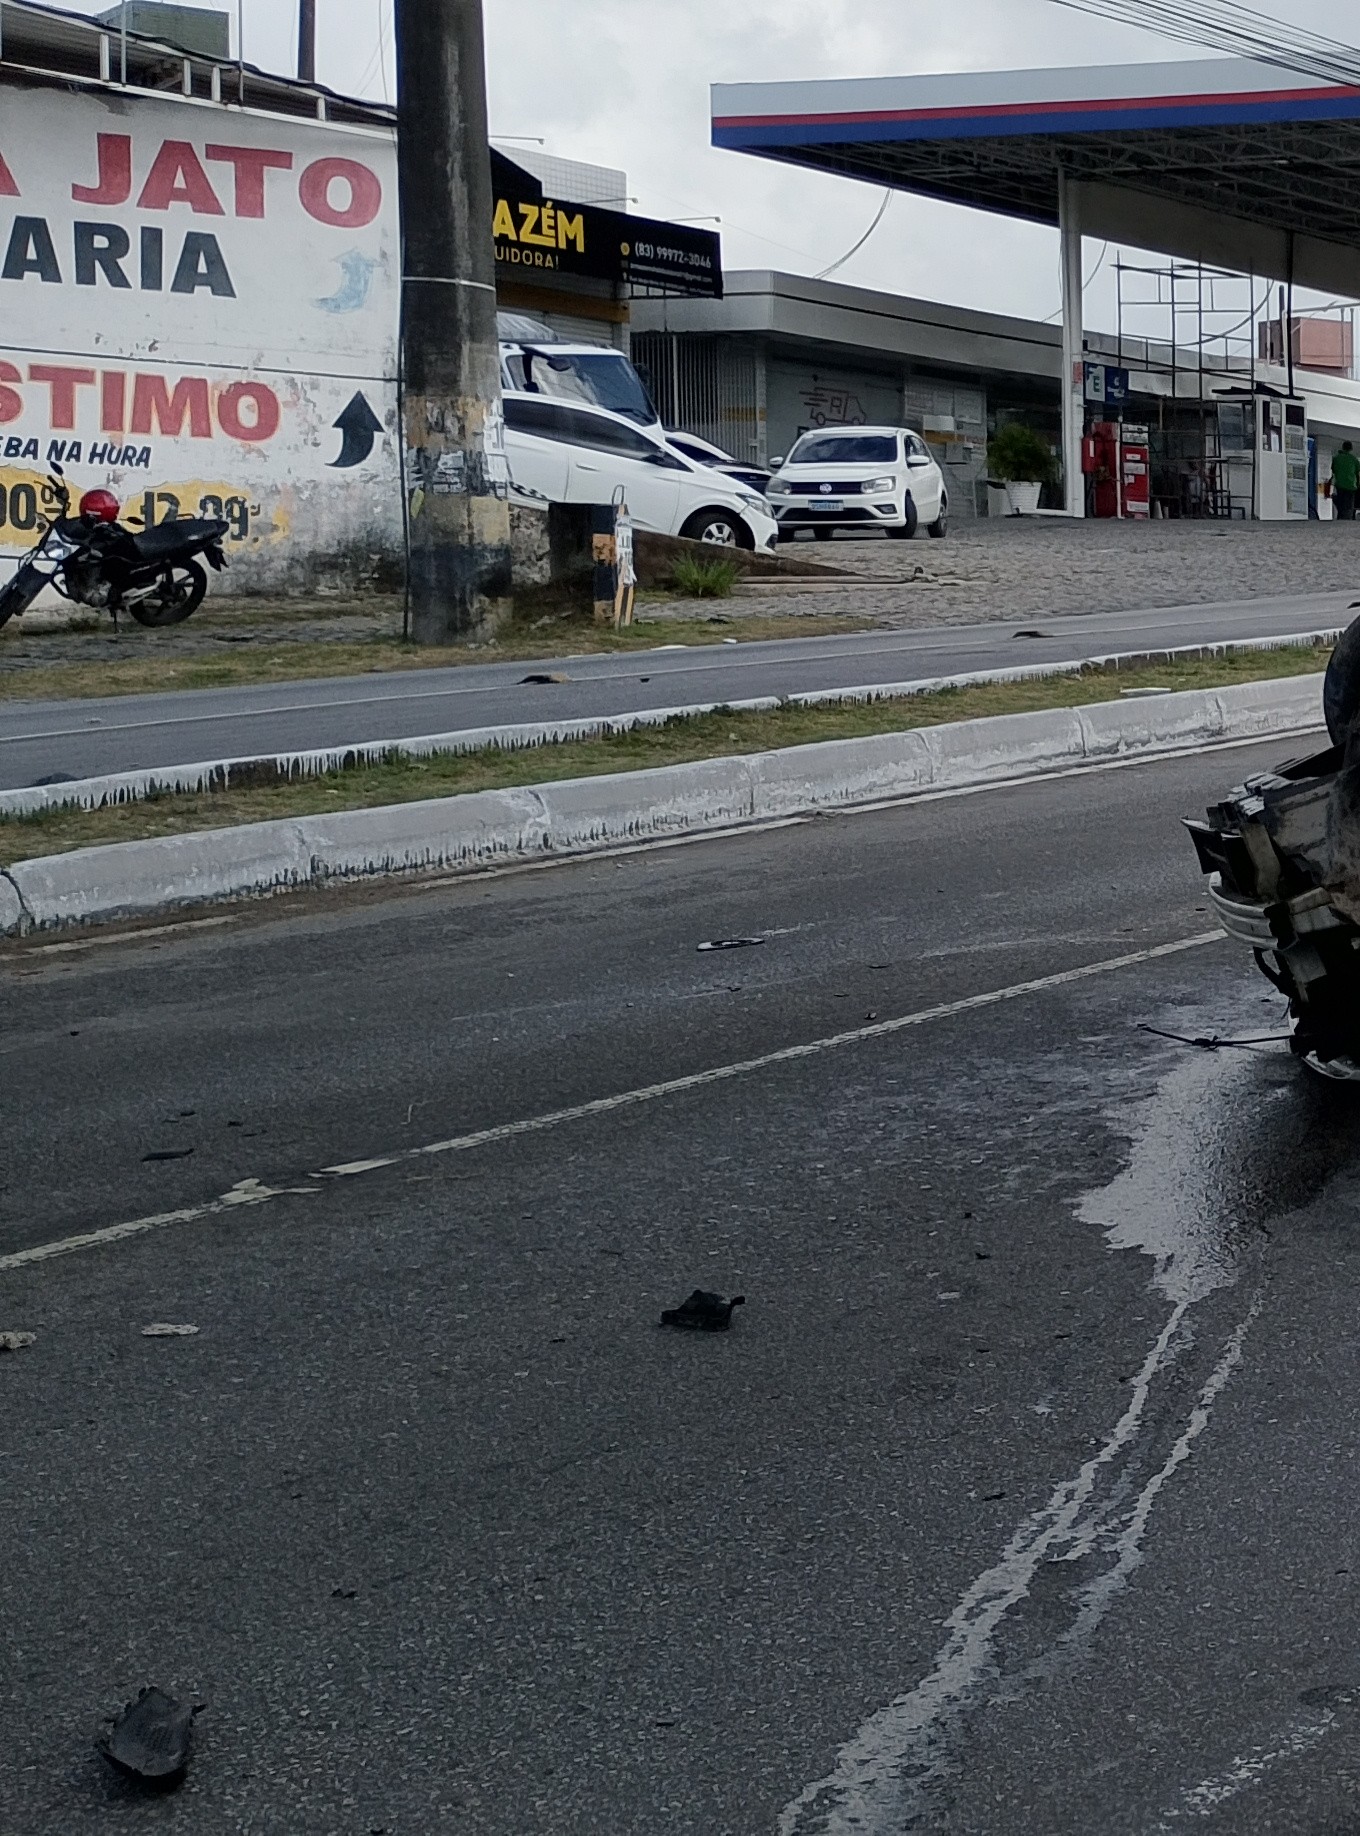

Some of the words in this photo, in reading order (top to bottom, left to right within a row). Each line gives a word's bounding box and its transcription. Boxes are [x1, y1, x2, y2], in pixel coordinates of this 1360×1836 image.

[71, 132, 382, 228] JATO
[492, 199, 585, 253] AZÉM
[1, 215, 237, 298] ARIA
[635, 241, 654, 259] (83)
[656, 246, 712, 269] 99972-3046
[0, 436, 39, 460] BA
[46, 439, 82, 462] NA
